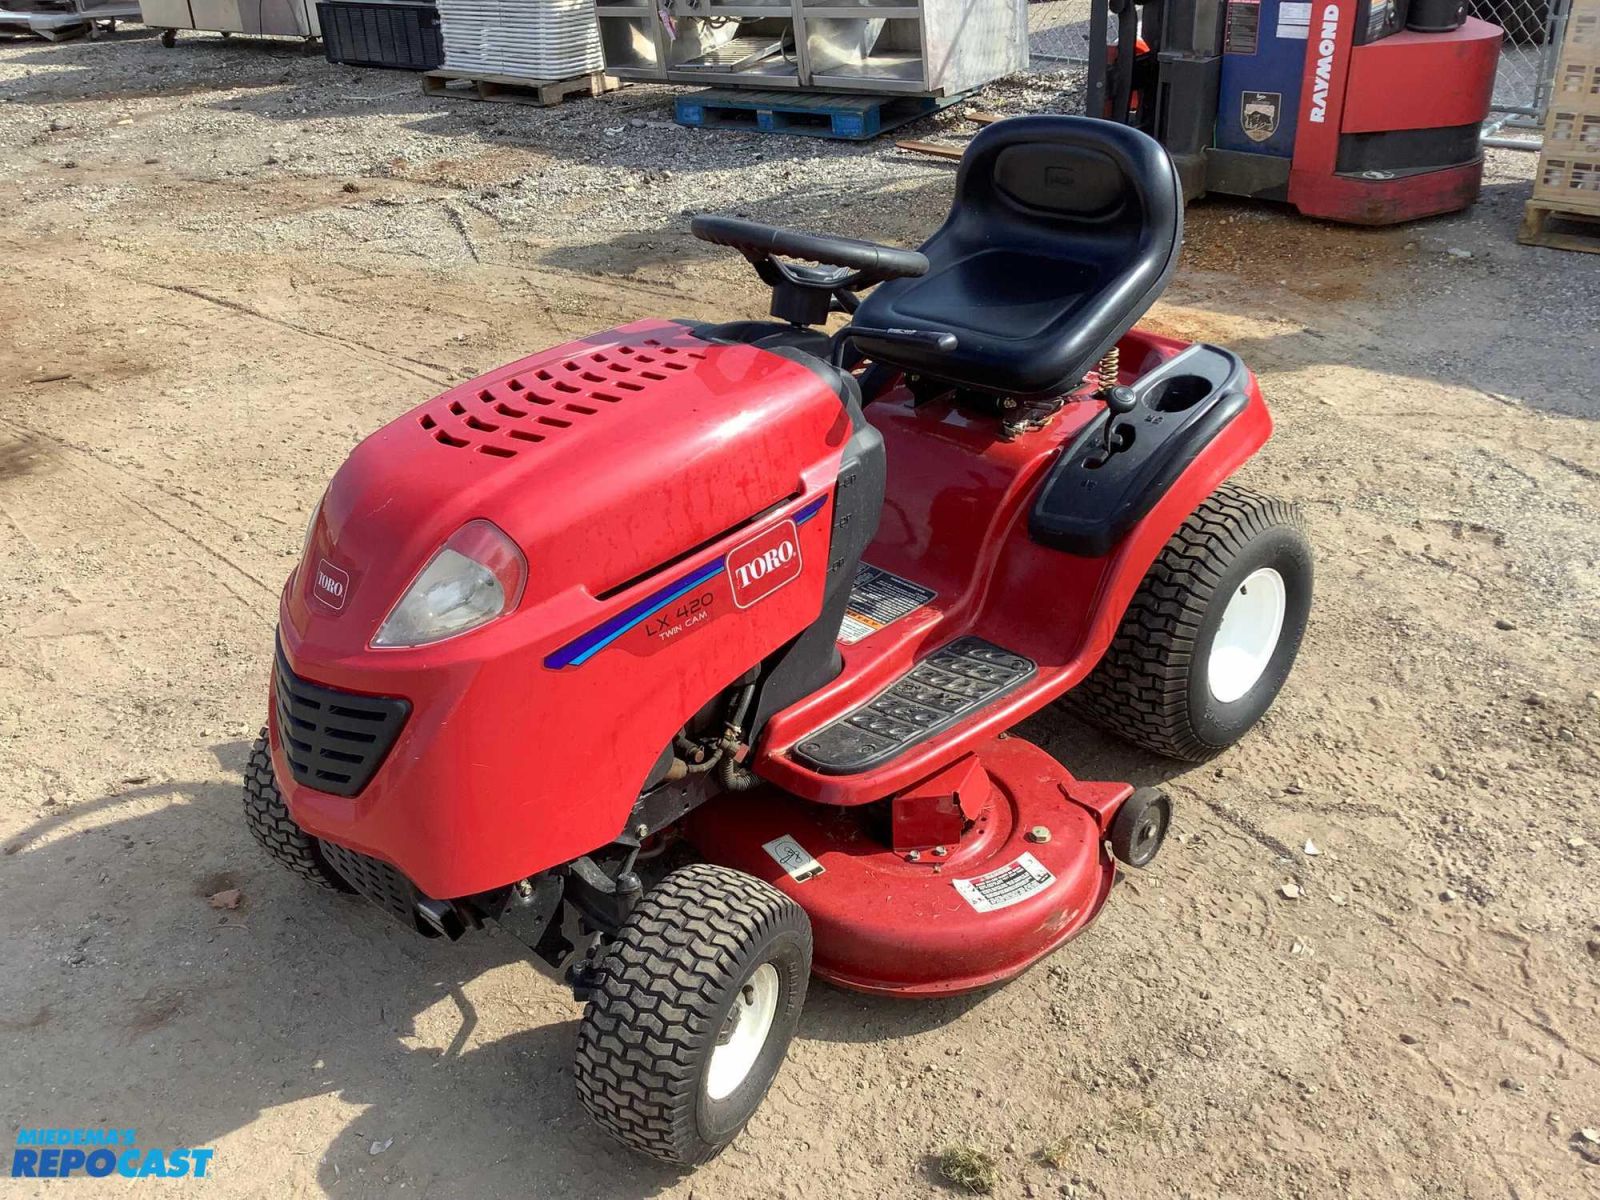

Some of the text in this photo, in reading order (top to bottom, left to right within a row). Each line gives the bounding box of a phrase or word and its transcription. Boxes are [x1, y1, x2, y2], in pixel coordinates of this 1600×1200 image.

[1310, 5, 1339, 122] RAYMOND
[318, 571, 343, 597] TORO
[735, 541, 794, 588] TORO
[647, 593, 713, 636] LX 420
[659, 612, 708, 640] TWIN CAM
